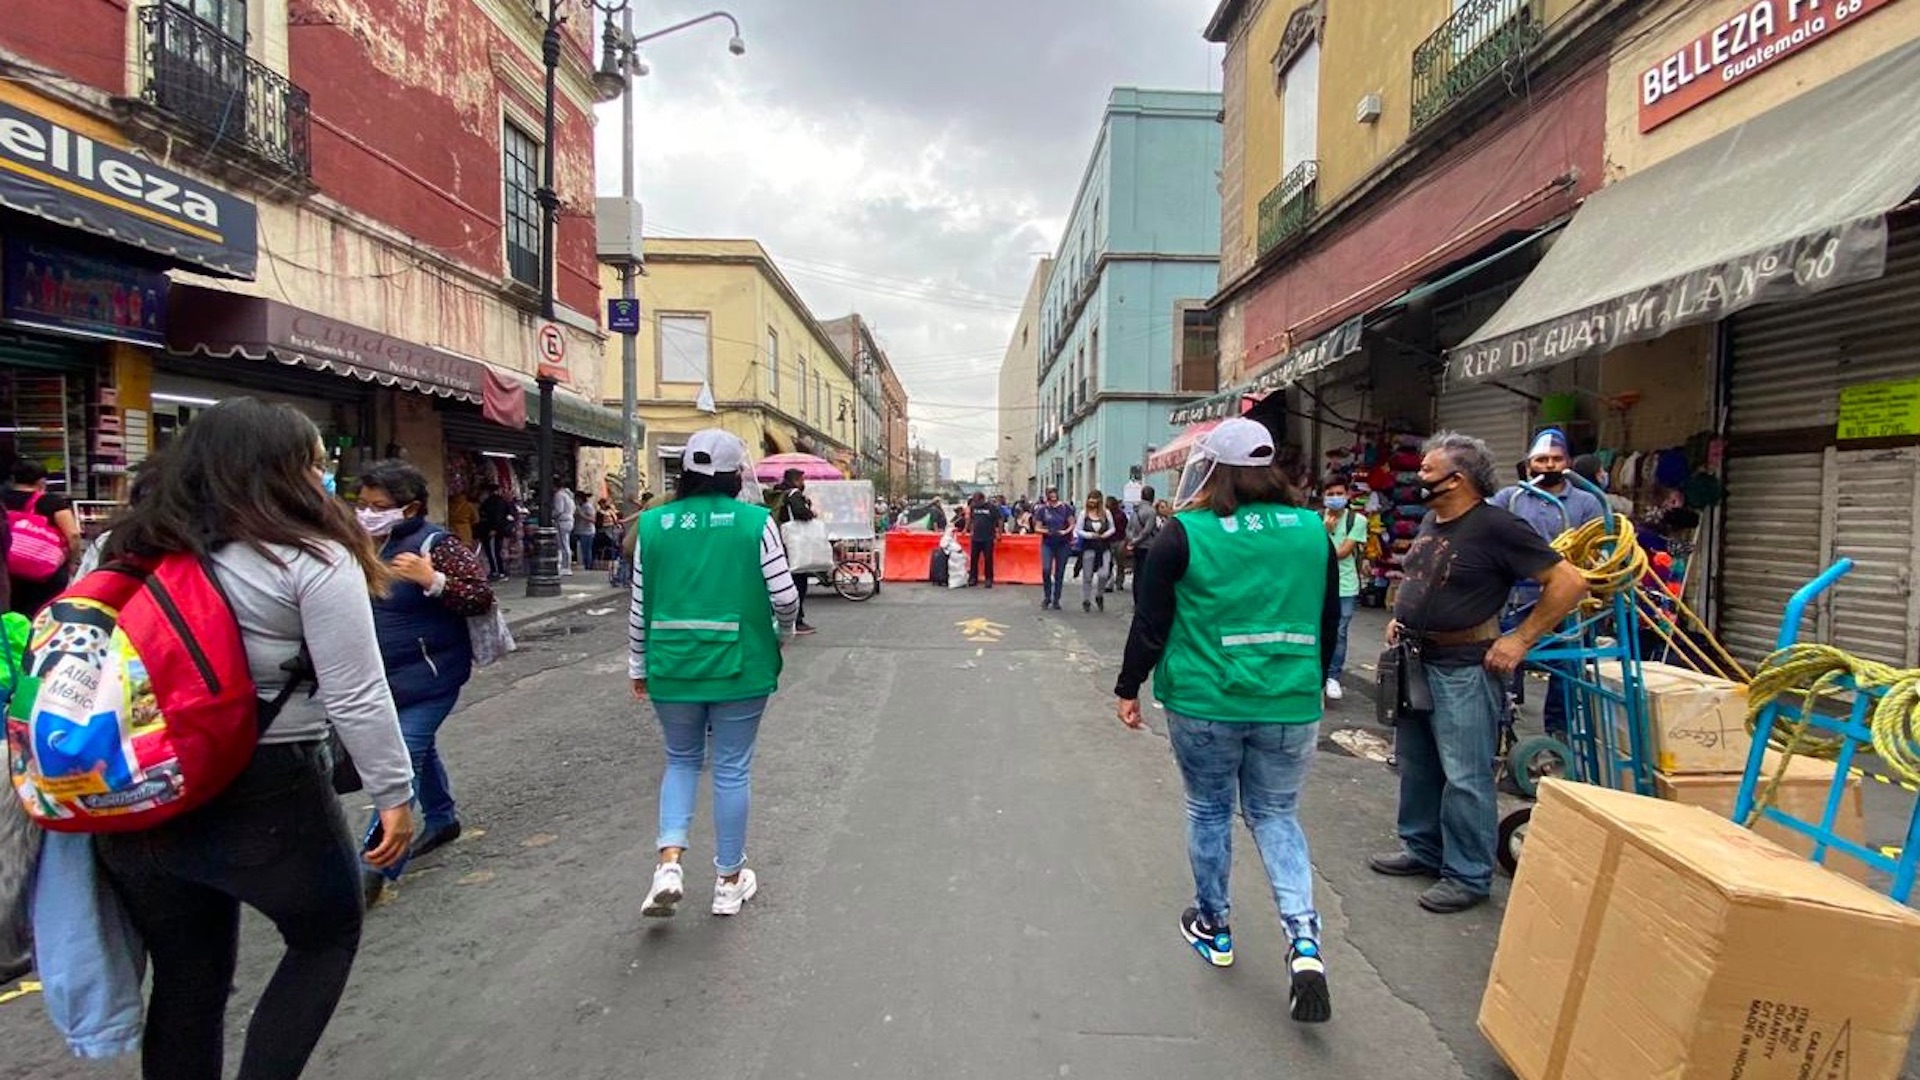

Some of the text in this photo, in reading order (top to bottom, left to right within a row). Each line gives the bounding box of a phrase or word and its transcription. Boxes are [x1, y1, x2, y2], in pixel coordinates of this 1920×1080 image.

[1643, 0, 1774, 106] BELLEZA
[1722, 17, 1826, 82] Guatemala
[1835, 0, 1863, 20] 68
[59, 664, 99, 691] Atlas
[1744, 1000, 1761, 1031] MADE
[1755, 1021, 1768, 1040] NO
[1788, 1007, 1810, 1053] ITEM NO
[1741, 1034, 1753, 1046] IN
[1763, 1003, 1787, 1060] QUANTITY
[1780, 1026, 1793, 1046] NO
